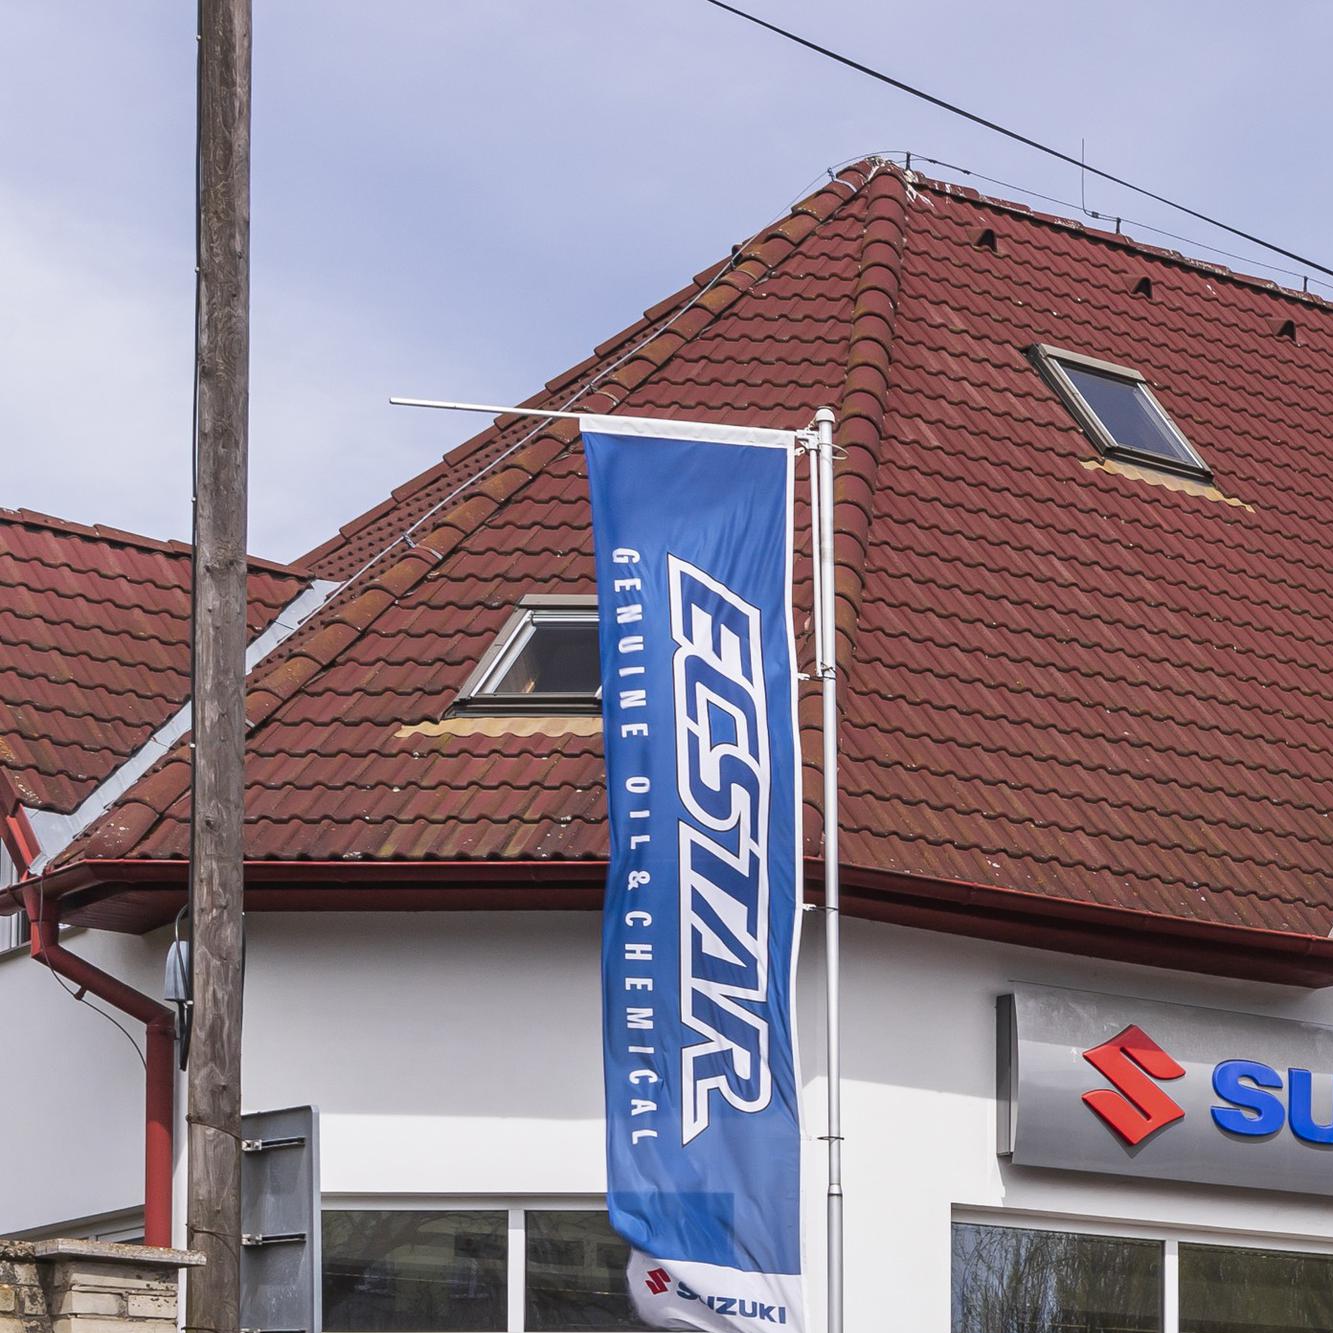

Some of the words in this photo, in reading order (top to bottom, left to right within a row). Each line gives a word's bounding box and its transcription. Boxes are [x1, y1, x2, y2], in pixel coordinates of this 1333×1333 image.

[611, 546, 649, 739] GENUINE
[624, 775, 651, 851] OIL
[627, 870, 651, 891] &
[667, 552, 772, 1147] ECSTAR
[624, 910, 659, 1146] CHEMICAL
